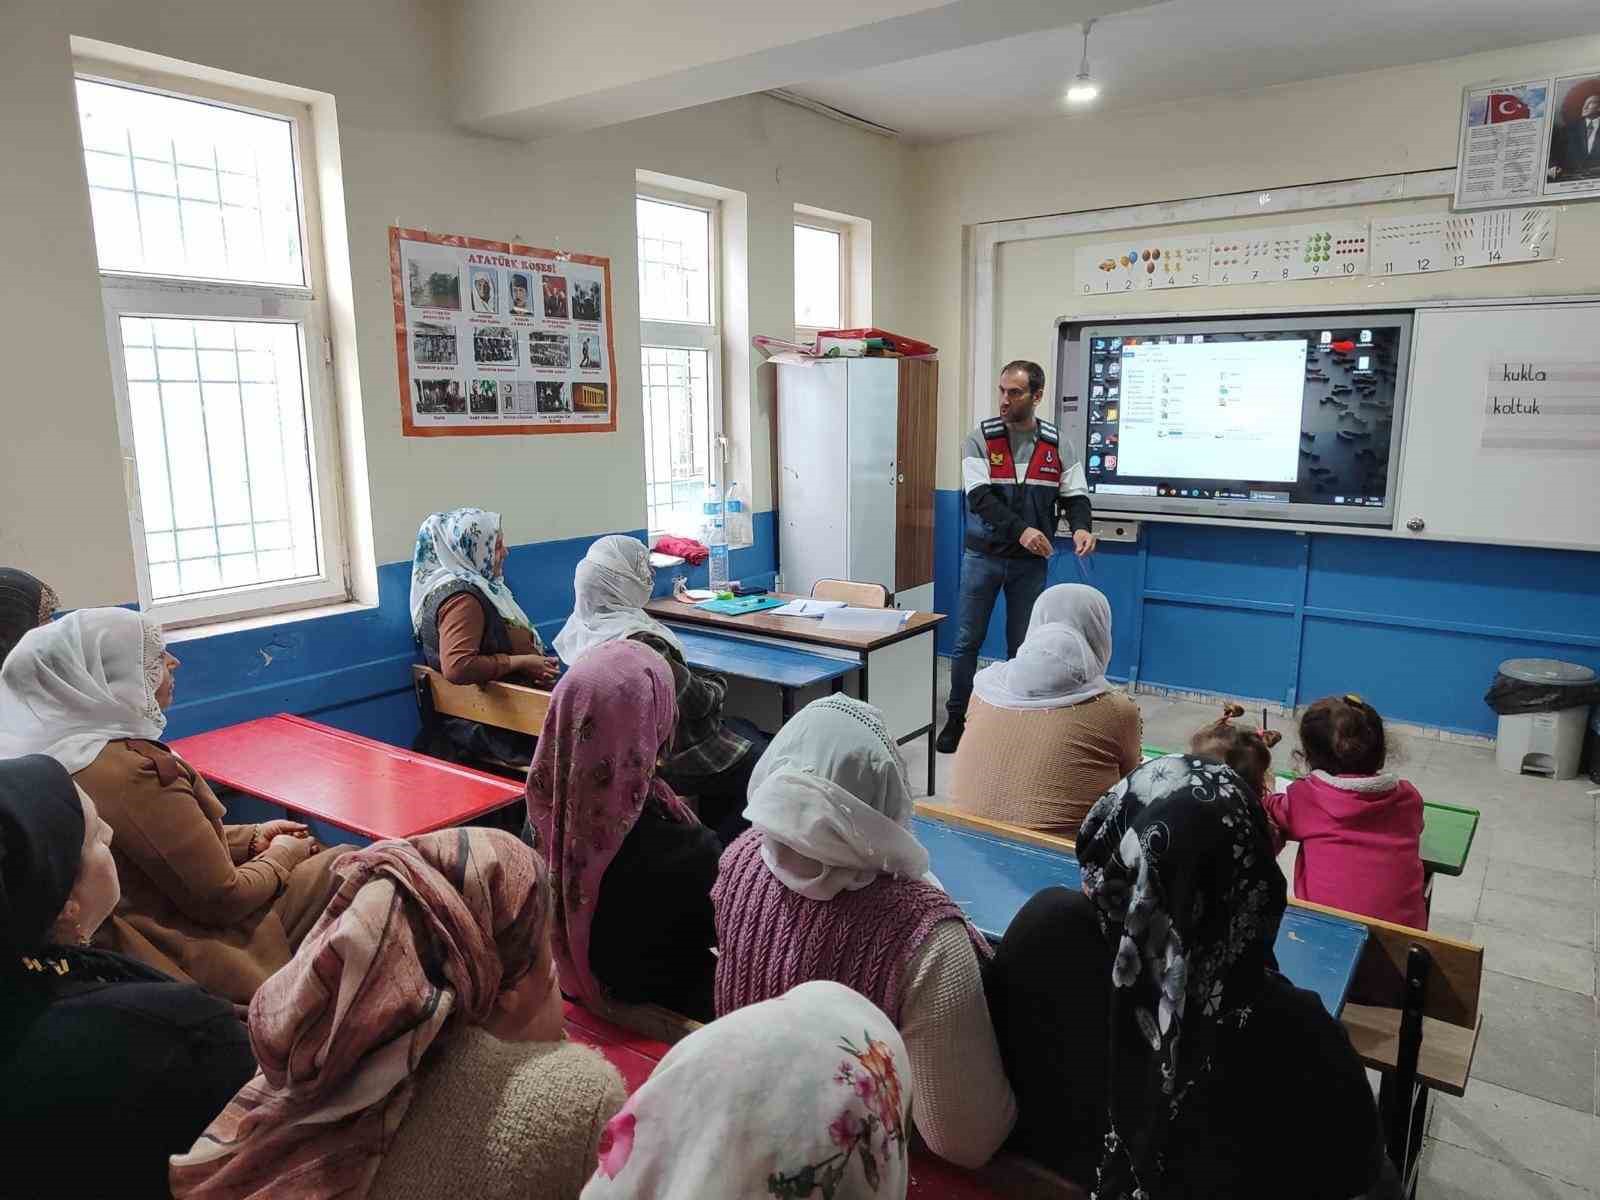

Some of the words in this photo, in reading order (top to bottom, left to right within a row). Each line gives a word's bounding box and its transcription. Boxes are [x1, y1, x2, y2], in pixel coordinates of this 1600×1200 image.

[1250, 271, 1258, 279] 7
[1281, 268, 1288, 278] 8
[1312, 264, 1319, 275] 9
[1343, 263, 1355, 273] 10
[1385, 263, 1393, 273] 11
[1417, 259, 1430, 270] 12
[1454, 256, 1465, 267] 13
[1489, 251, 1501, 262] 14
[1125, 280, 1132, 289] 2
[1147, 278, 1153, 287] 3
[1168, 275, 1175, 285] 4
[1191, 273, 1199, 283] 5
[1503, 363, 1546, 382] kukla
[1493, 397, 1540, 415] koltuk
